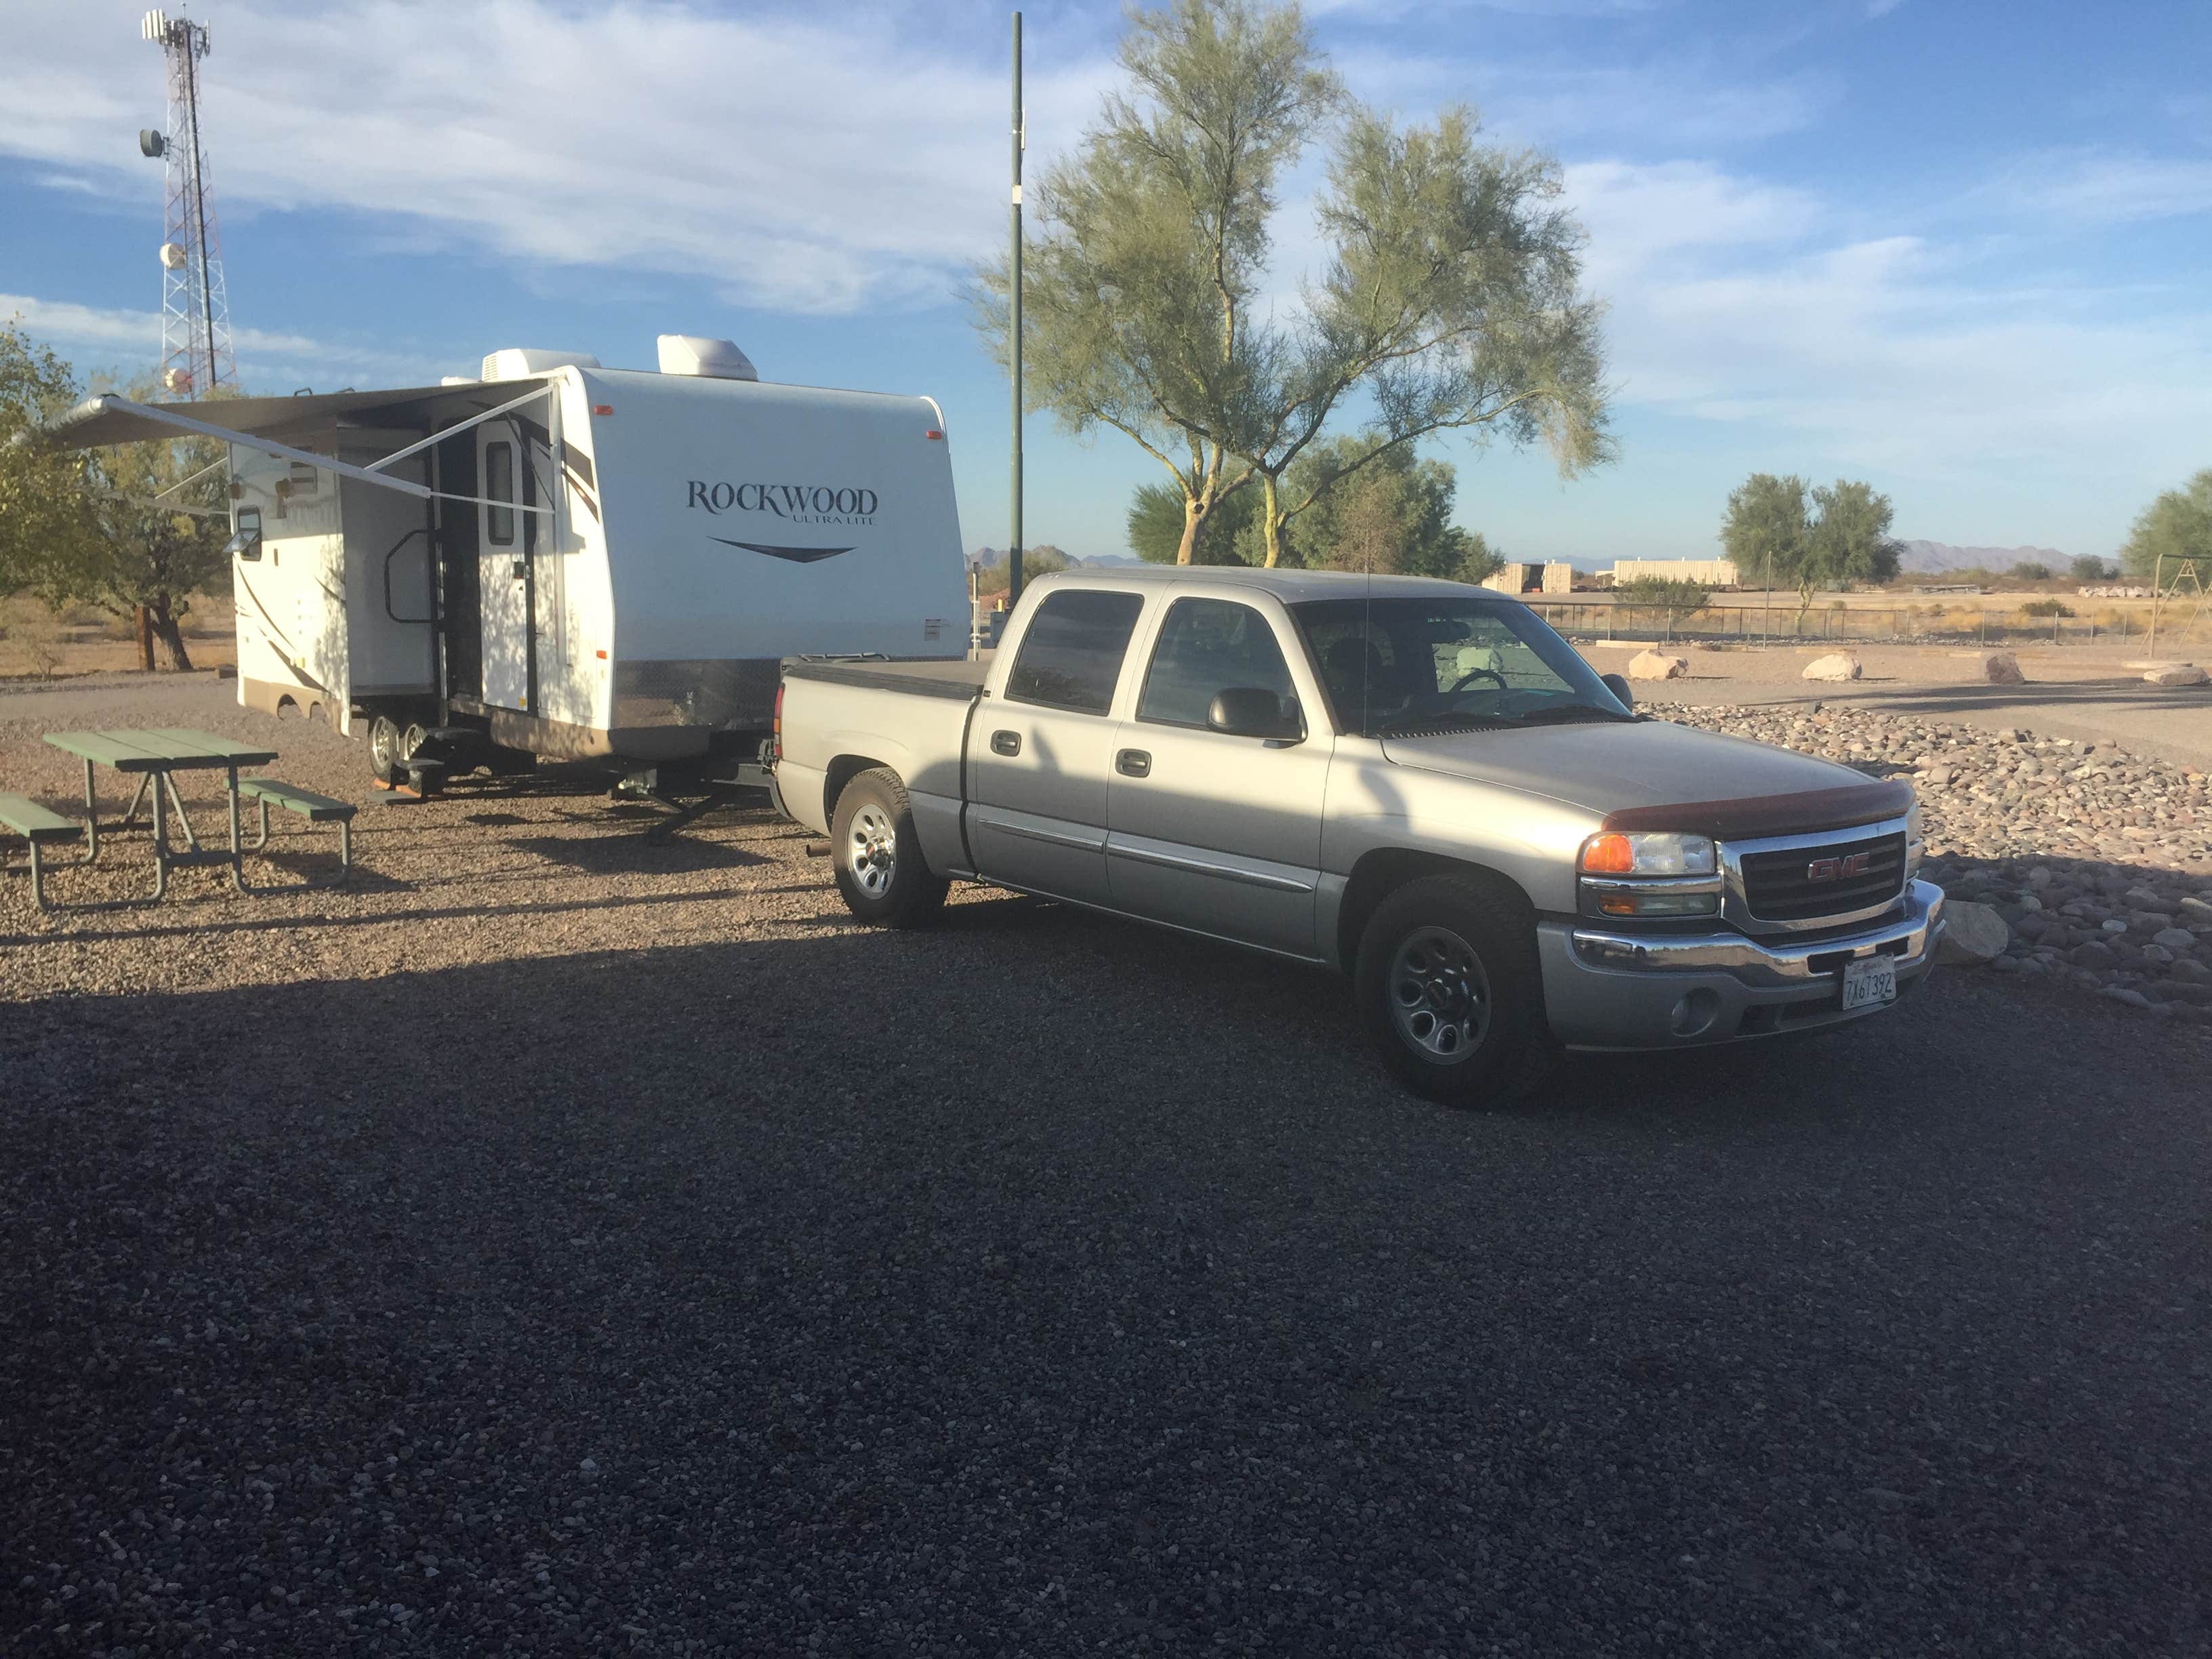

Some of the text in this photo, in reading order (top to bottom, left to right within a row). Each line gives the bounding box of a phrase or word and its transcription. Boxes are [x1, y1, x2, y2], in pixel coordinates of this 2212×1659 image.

[687, 480, 878, 518] ROCKWOOD
[793, 514, 877, 525] ULTRA LITE
[1807, 852, 1869, 882] GMC
